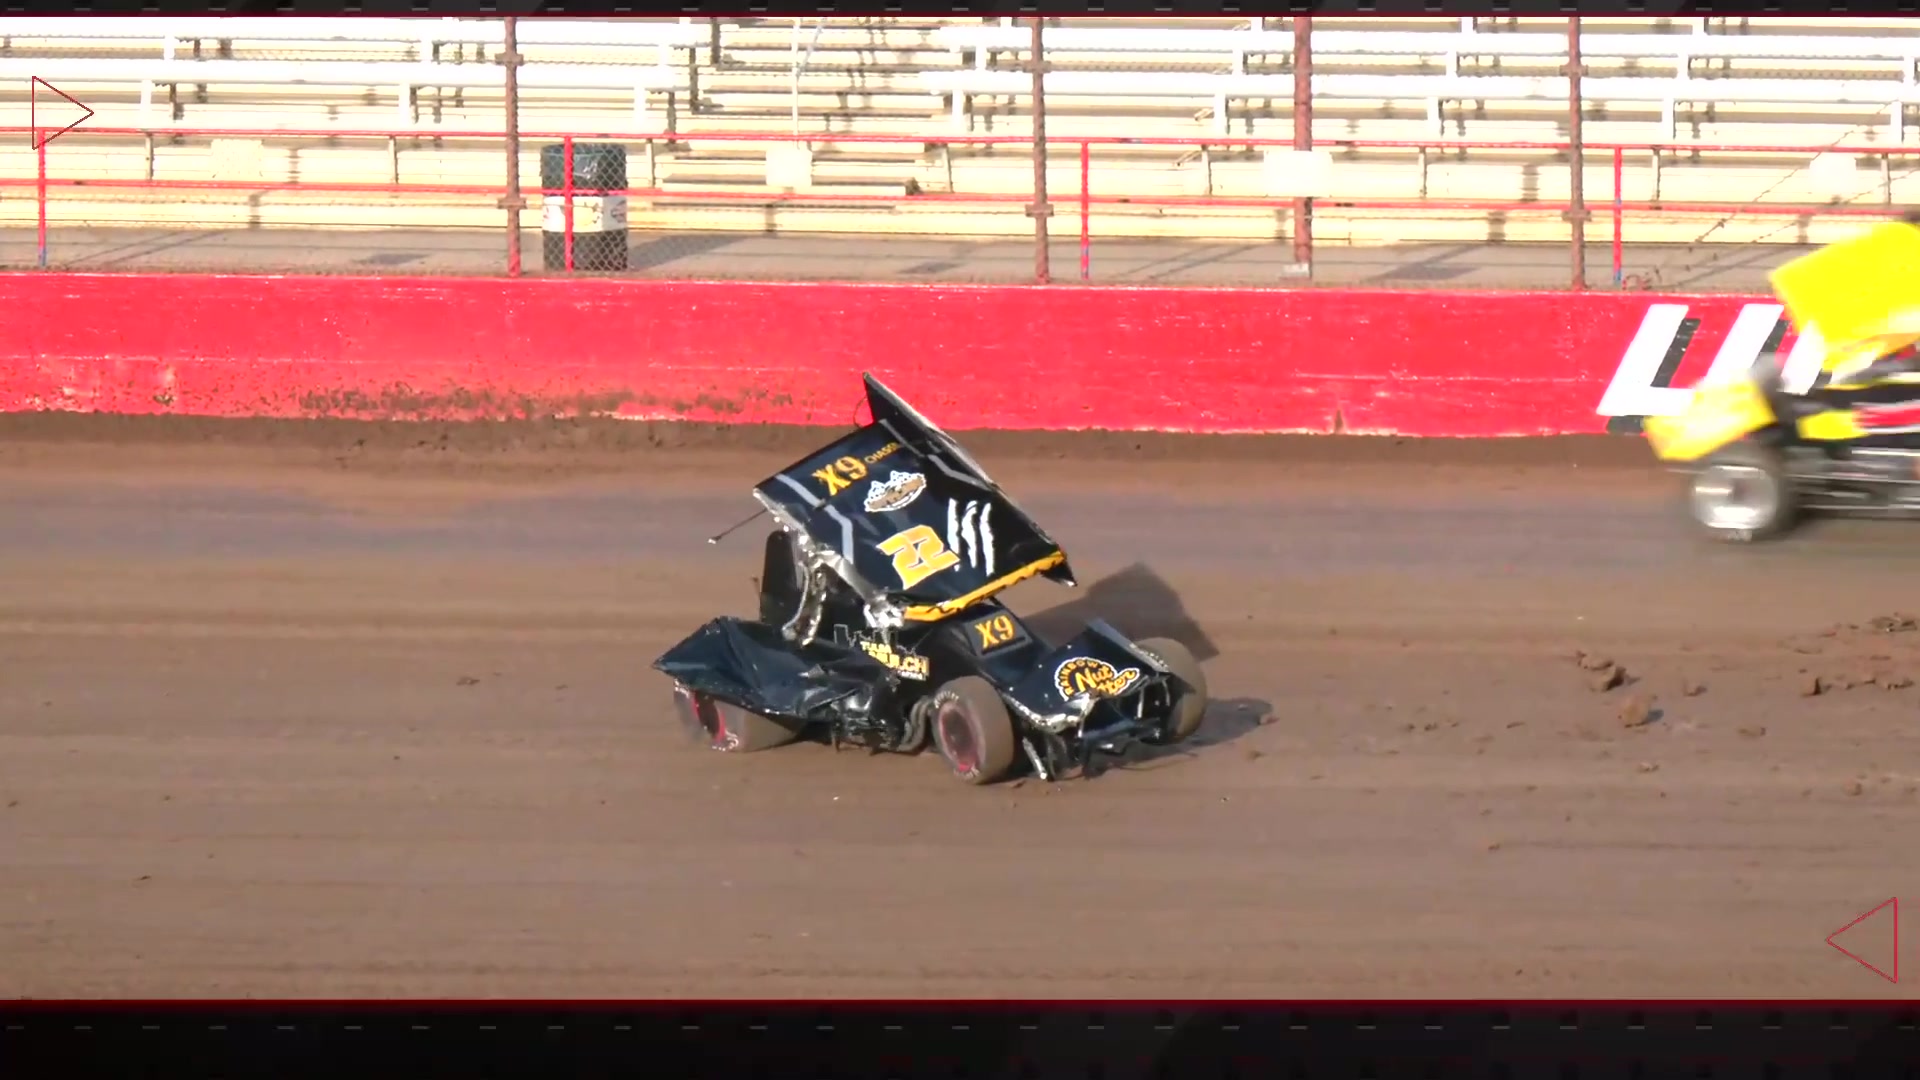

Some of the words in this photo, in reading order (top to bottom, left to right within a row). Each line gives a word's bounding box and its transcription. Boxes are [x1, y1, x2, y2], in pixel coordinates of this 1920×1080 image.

[812, 455, 868, 496] X9
[864, 442, 902, 464] CHASSI
[876, 524, 960, 590] 22
[974, 614, 1015, 649] X9
[1075, 667, 1113, 693] Nut
